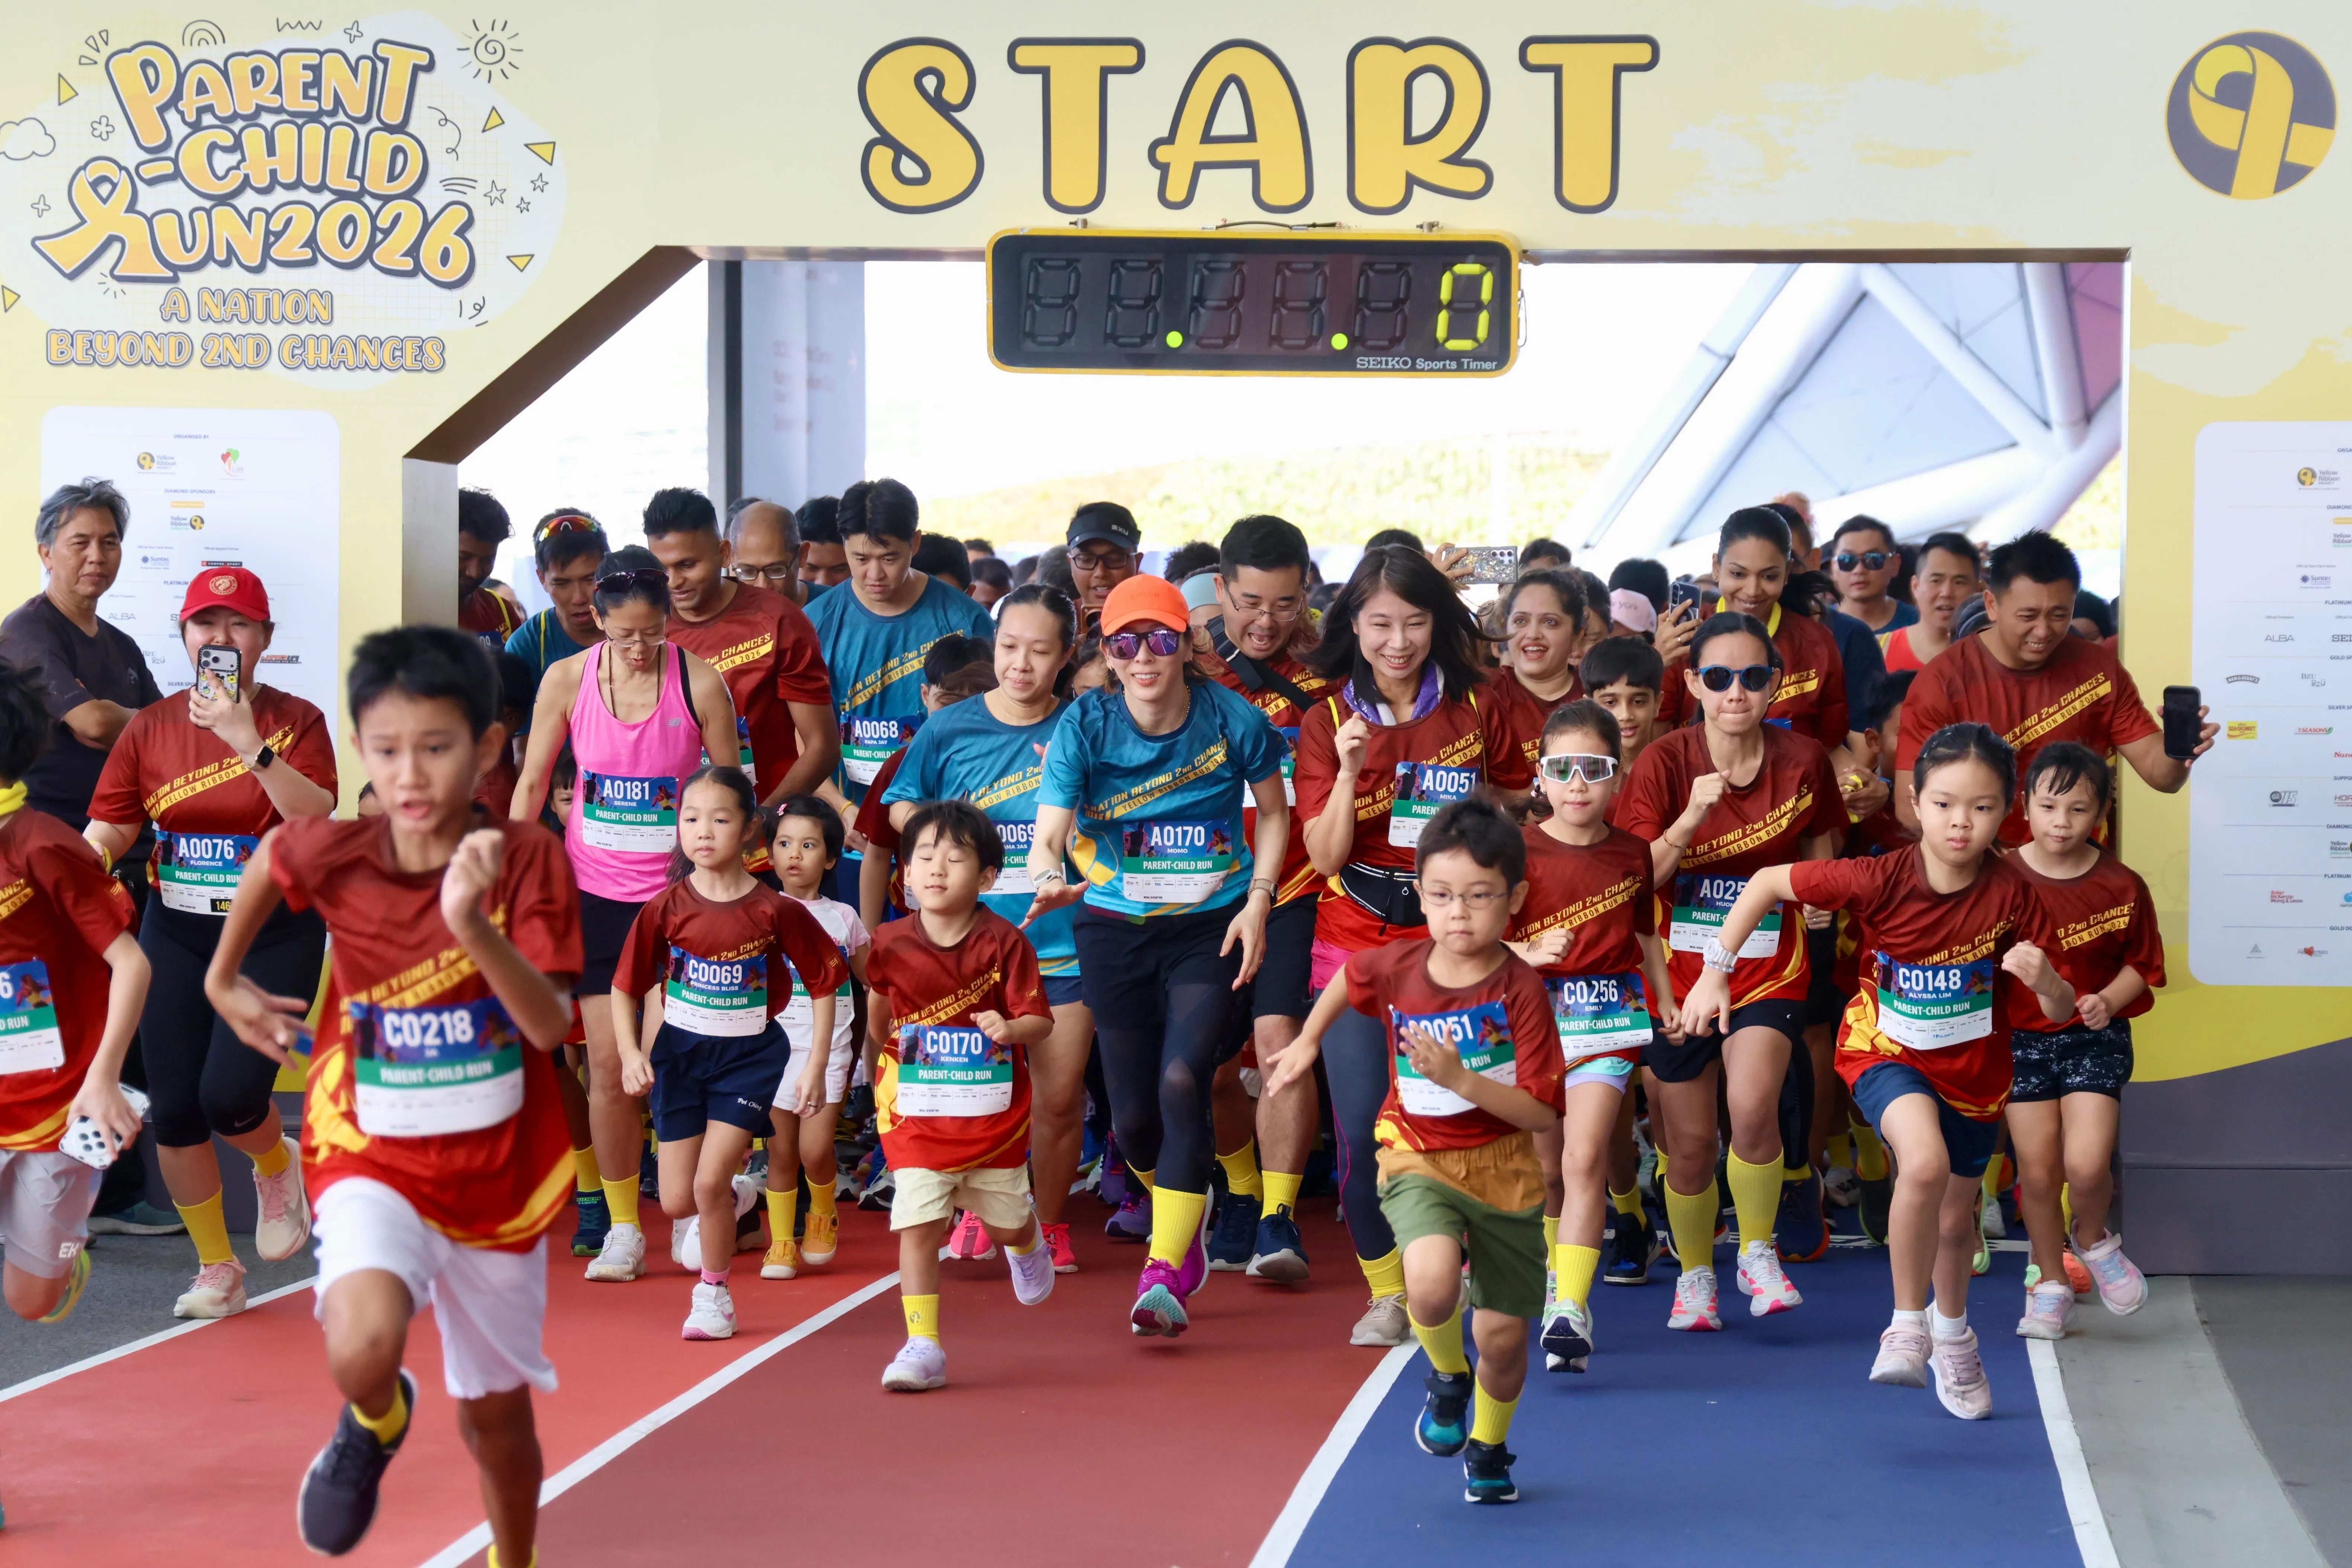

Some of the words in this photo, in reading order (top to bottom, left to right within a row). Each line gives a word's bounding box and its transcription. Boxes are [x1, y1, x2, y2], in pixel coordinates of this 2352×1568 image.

[107, 40, 435, 152] PARENT
[858, 35, 1660, 215] START
[135, 119, 427, 201] -CHILD
[160, 287, 190, 322] A
[199, 287, 334, 325] NATION
[47, 330, 192, 367] BEYOND
[201, 332, 270, 368] 2ND
[279, 334, 446, 371] CHANCES
[1356, 357, 1412, 369] SEIKO
[1416, 358, 1457, 370] Sports
[1461, 358, 1498, 369] Timer
[1111, 524, 1129, 536] 2XU
[722, 632, 771, 659] CHANCES
[718, 658, 736, 671] RUN
[739, 650, 761, 662] 2026
[902, 650, 918, 662] 2ND
[887, 663, 915, 682] RIBBON
[2041, 703, 2059, 719] 2ND
[2060, 672, 2105, 707] CHANCES
[2026, 717, 2059, 742] RIBBON
[2060, 704, 2079, 720] RUN
[2079, 691, 2100, 707] 2026
[855, 720, 899, 739] A0068
[1439, 728, 1482, 759] CHANCES
[853, 749, 891, 759] PARENT-CHILD
[1458, 748, 1477, 762] 2026
[173, 762, 219, 788] BEYOND
[222, 756, 242, 769] 2ND
[1422, 769, 1476, 794] A0051
[164, 783, 196, 806] YELLOW
[201, 769, 237, 788] RIBBON
[603, 779, 649, 800] A0181
[978, 771, 1023, 798] BEYOND
[1006, 777, 1040, 796] RIBBON
[1091, 791, 1128, 812] NATION
[1131, 771, 1173, 797] BEYOND
[1175, 765, 1192, 777] 2ND
[1122, 792, 1155, 811] YELLOW
[1157, 775, 1191, 794] RIBBON
[1194, 765, 1211, 778] RUN
[596, 809, 642, 822] PARENT-CHILD
[643, 814, 658, 822] RUN
[1365, 799, 1392, 817] YELLO
[996, 824, 1035, 843] 0069
[1151, 826, 1205, 846] A0170
[1696, 828, 1742, 855] BEYOND
[1745, 820, 1764, 835] 2ND
[178, 838, 235, 860] A0076
[1685, 851, 1722, 868] YELLOW
[1726, 833, 1763, 856] RIBBON
[1765, 822, 1784, 838] RUN
[1143, 861, 1195, 870] PARENT-CHILD
[1197, 860, 1212, 870] RUN
[175, 870, 224, 883] PARENT-CHILD
[226, 874, 241, 883] RUN
[6, 893, 29, 913] 2026
[1543, 901, 1583, 927] BEYOND
[1585, 894, 1602, 907] 2ND
[1568, 906, 1600, 926] RIBBON
[1603, 898, 1618, 911] RUN
[2068, 921, 2087, 935] 2ND
[2087, 923, 2106, 939] RUN
[721, 950, 737, 961] 2ND
[1952, 943, 1972, 957] 2ND
[1973, 944, 1992, 960] RUN
[688, 959, 742, 984] C0069
[1898, 967, 1961, 992] C0148
[690, 980, 720, 991] PRINCESS
[1563, 980, 1619, 1005] C0256
[682, 989, 731, 1006] PARENT-CHILD
[732, 996, 748, 1006] RUN
[921, 994, 955, 1018] BEYOND
[944, 997, 972, 1017] RIBBON
[1893, 999, 1951, 1016] PARENT-CHILD
[1953, 1001, 1970, 1013] RUN
[7, 1016, 29, 1029] RUN
[384, 1009, 474, 1047] C0218
[1559, 1019, 1613, 1031] PARENT-CHILD
[1615, 1017, 1631, 1027] RUN
[926, 1031, 982, 1055] C0170
[1471, 1054, 1491, 1069] RUN
[380, 1066, 463, 1084] PARENT-CHILD
[466, 1060, 494, 1077] RUN
[918, 1069, 973, 1080] PARENT-CHILD
[975, 1070, 992, 1080] RUN
[748, 1101, 762, 1111] Ching
